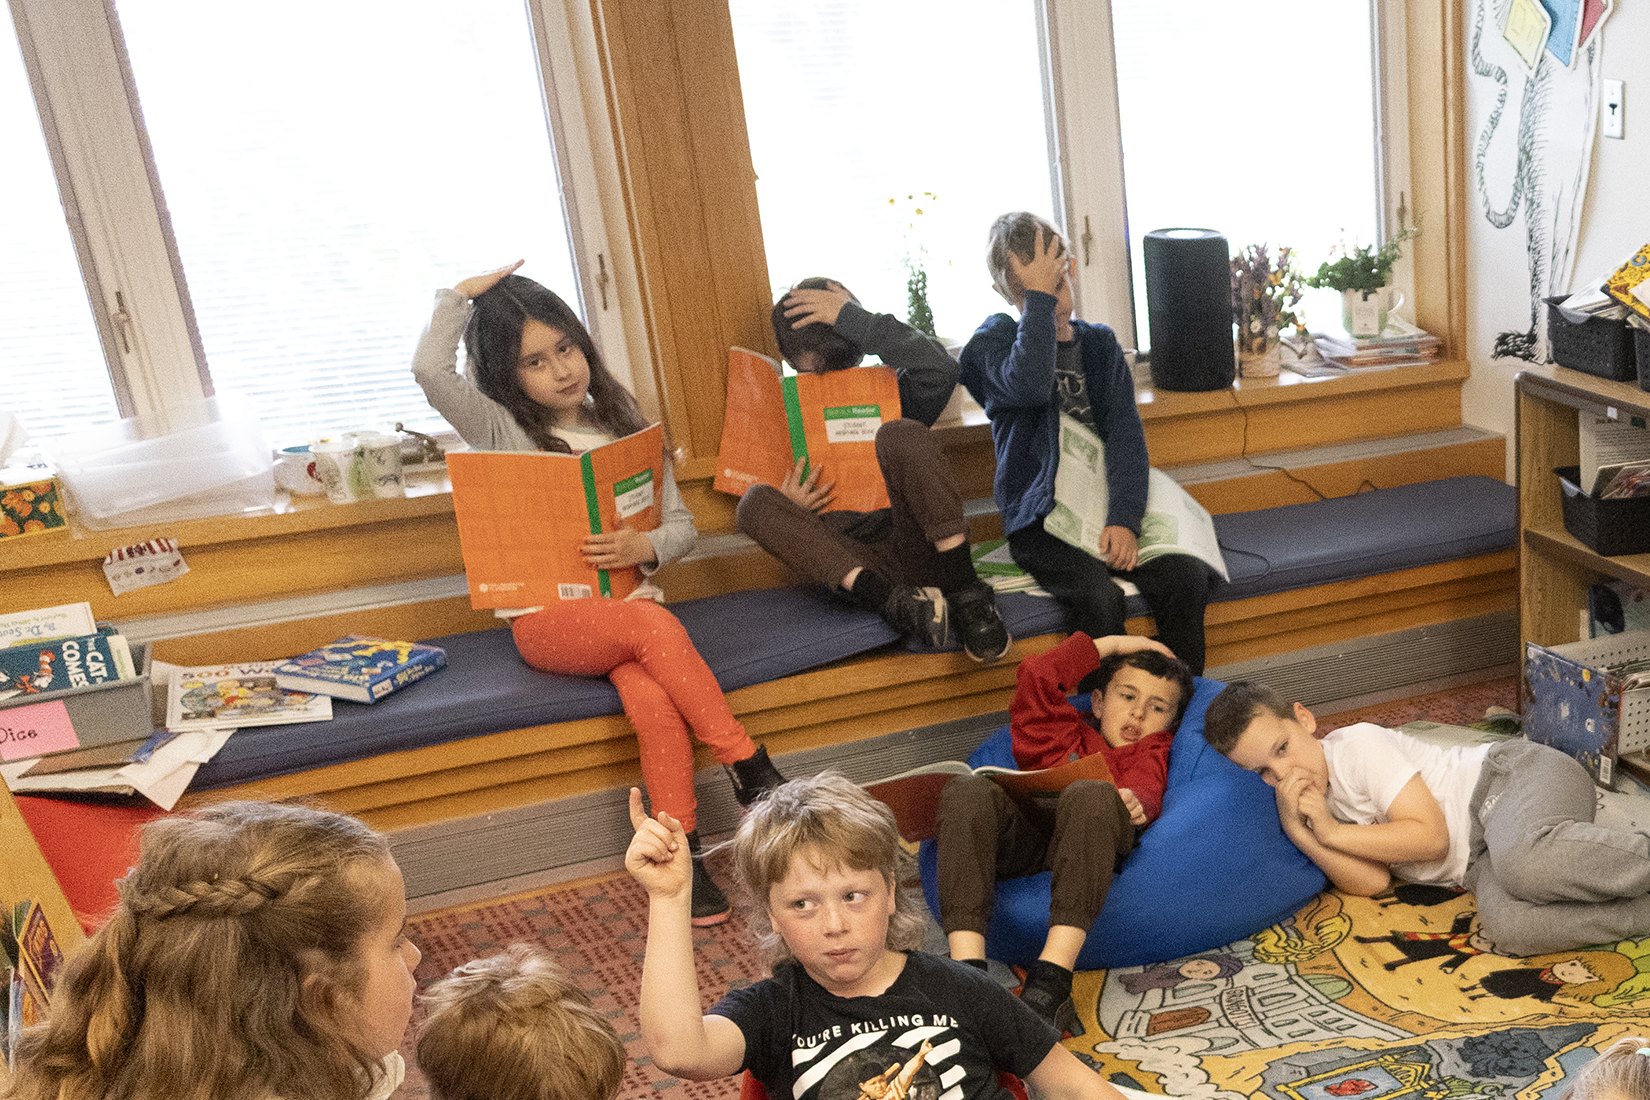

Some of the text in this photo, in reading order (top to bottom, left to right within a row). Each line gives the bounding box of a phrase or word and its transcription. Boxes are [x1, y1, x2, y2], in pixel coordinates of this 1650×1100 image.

[62, 641, 90, 689] COMES
[86, 652, 107, 678] CAT
[182, 668, 230, 680] 500
[792, 1014, 959, 1048] OU'RE KILLING ME
